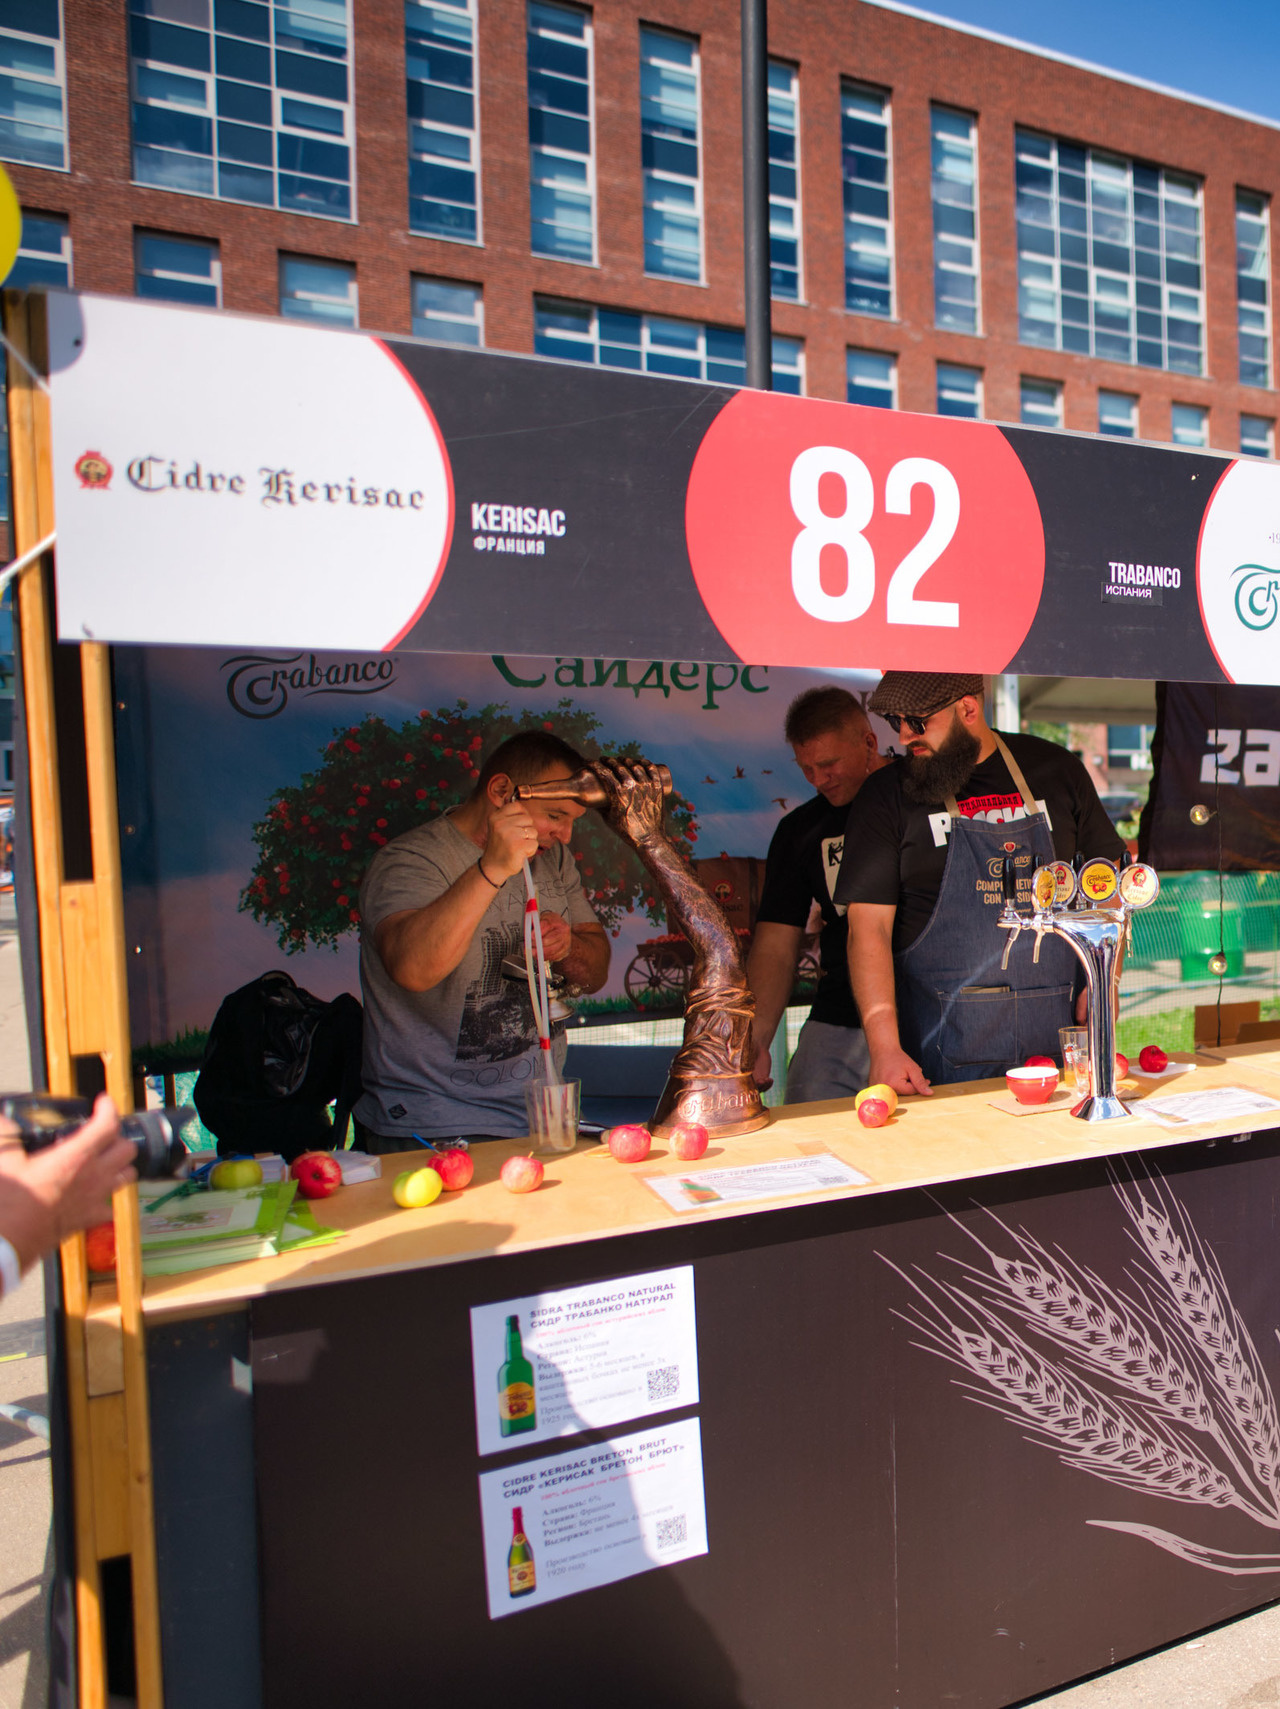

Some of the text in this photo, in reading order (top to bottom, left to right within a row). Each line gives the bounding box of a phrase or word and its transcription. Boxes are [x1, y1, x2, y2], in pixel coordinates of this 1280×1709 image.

[127, 455, 426, 510] Cidre Kerisac
[471, 502, 566, 538] KERISAC
[788, 445, 961, 629] 82
[473, 536, 545, 555] ФРАНЦИЯ
[1105, 584, 1152, 599] ИСПАНИЯ
[1108, 561, 1181, 589] TRABANCO
[219, 652, 399, 719] Trabanco
[984, 893, 1001, 904] CON
[530, 1282, 676, 1318] SIDRA TRABANCO NATURAL
[530, 1293, 673, 1328] СИДР ТРАБАНКО НАТУРАЛ
[503, 1438, 666, 1489] CIDRE KERISAC BRETON BRUT
[503, 1484, 535, 1499] СИДР
[601, 1455, 643, 1472] БРЕТОН
